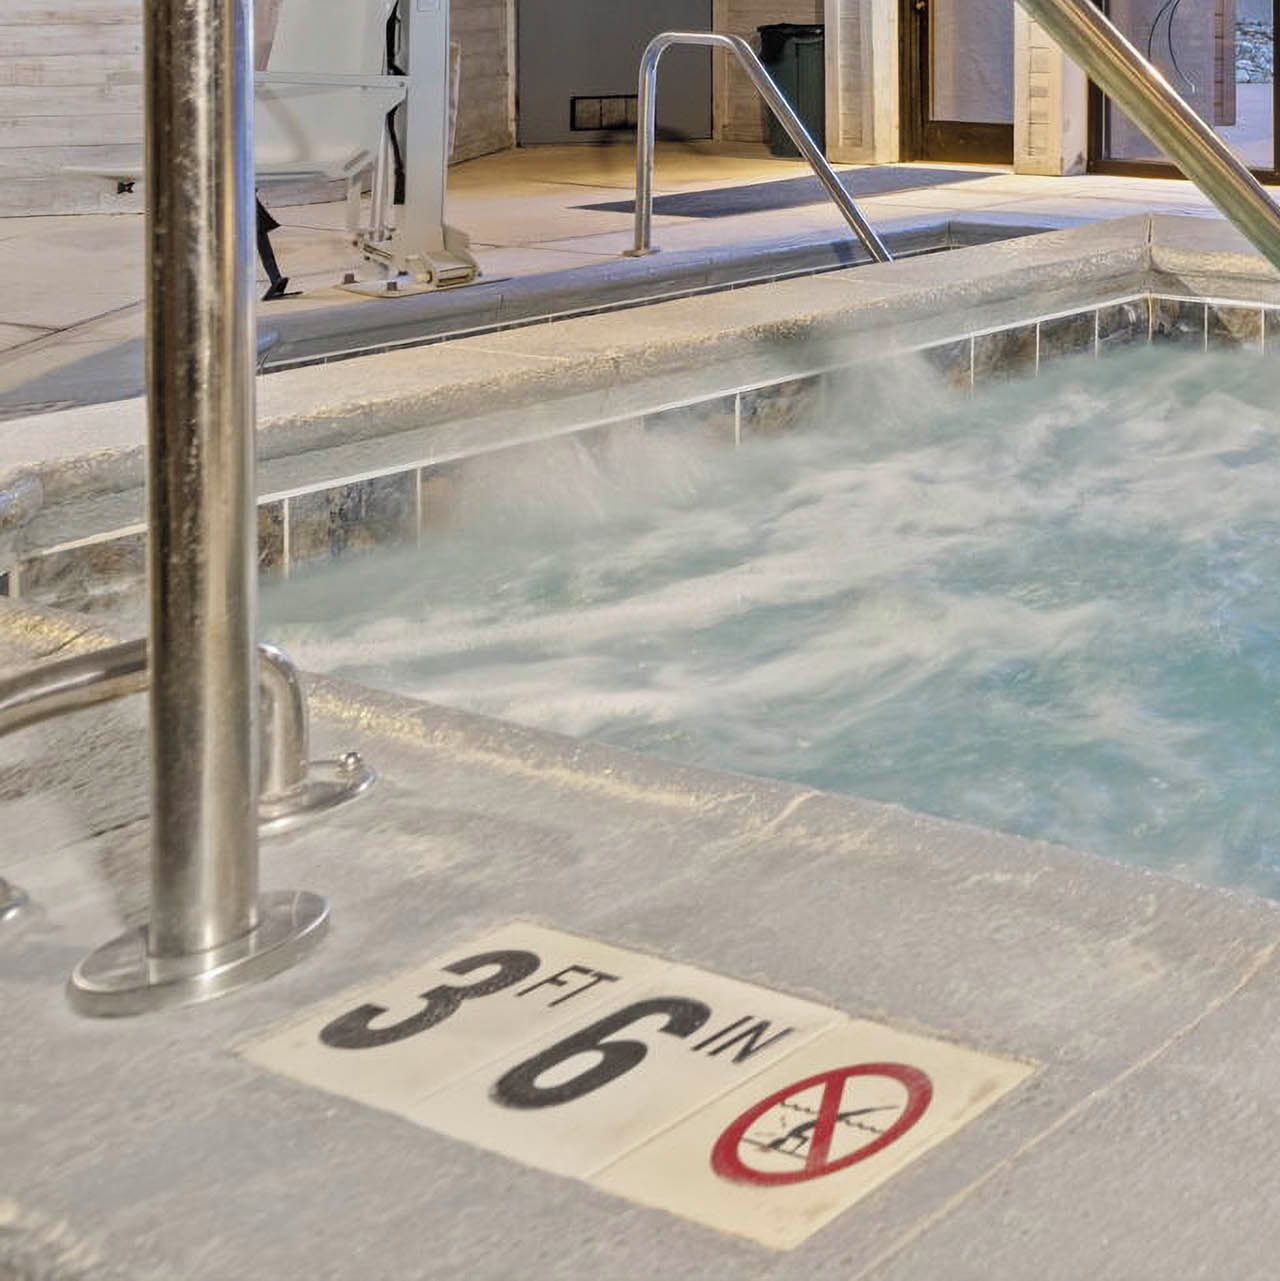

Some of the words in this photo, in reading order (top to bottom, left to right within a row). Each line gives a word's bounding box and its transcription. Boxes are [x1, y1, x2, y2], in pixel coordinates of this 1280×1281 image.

[319, 949, 541, 1050] 3
[515, 964, 621, 1008] FT
[489, 996, 712, 1111] 6
[690, 1015, 795, 1064] IN
